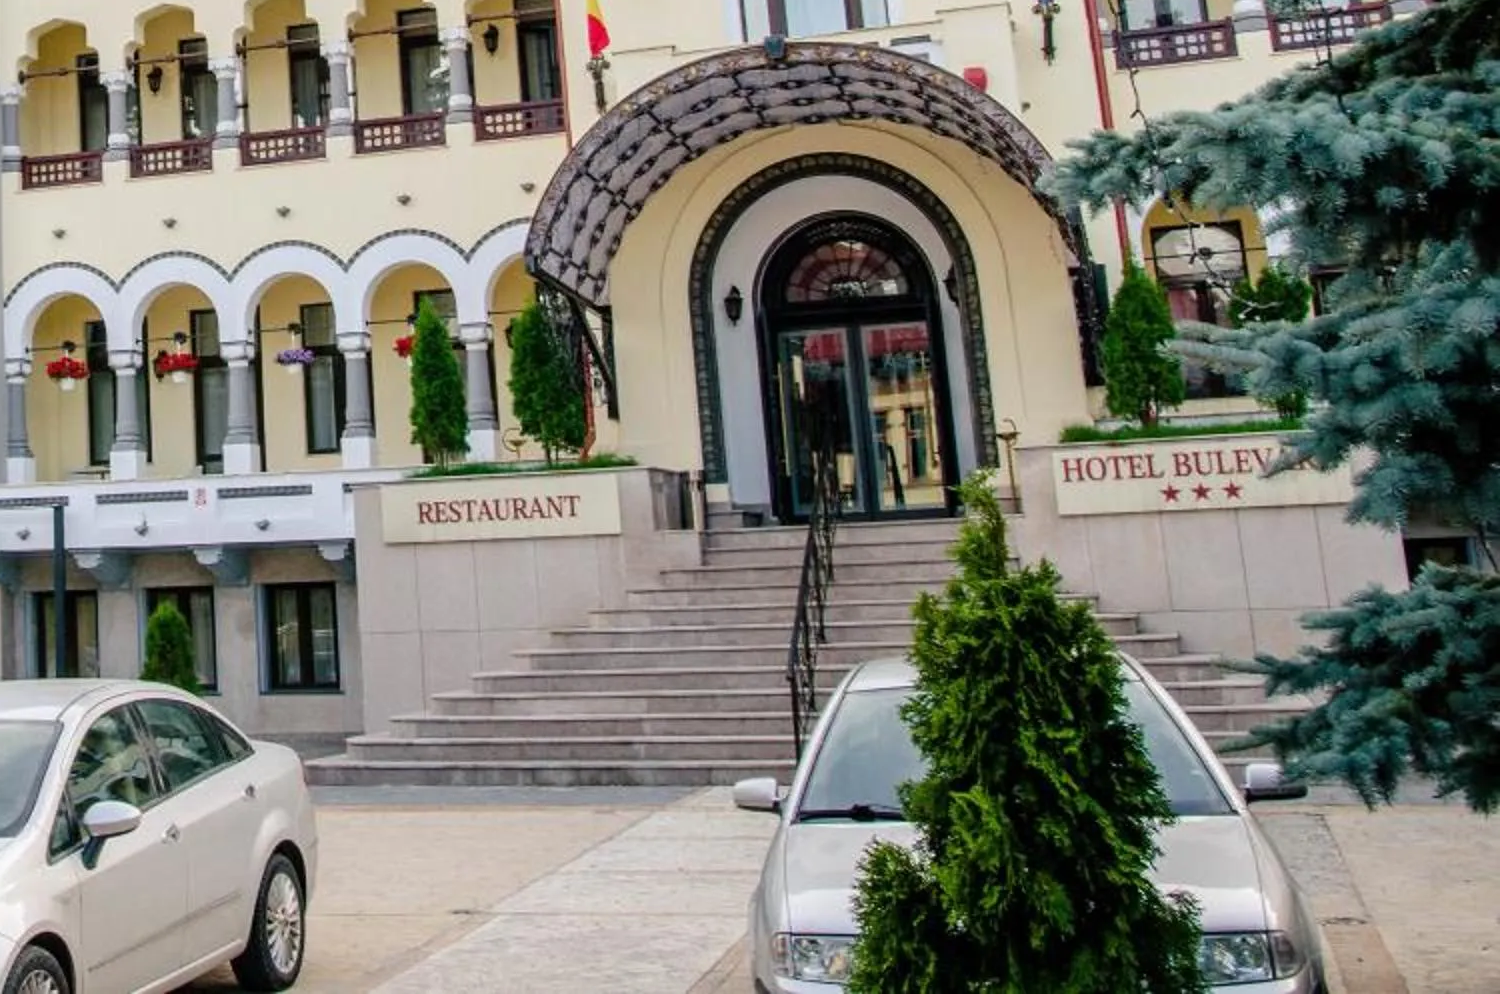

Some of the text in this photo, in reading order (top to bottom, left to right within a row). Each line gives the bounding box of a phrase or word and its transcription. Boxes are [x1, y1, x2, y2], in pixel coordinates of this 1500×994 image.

[1061, 447, 1318, 482] HOTEL BULEV
[418, 495, 581, 524] RESTAURANT
